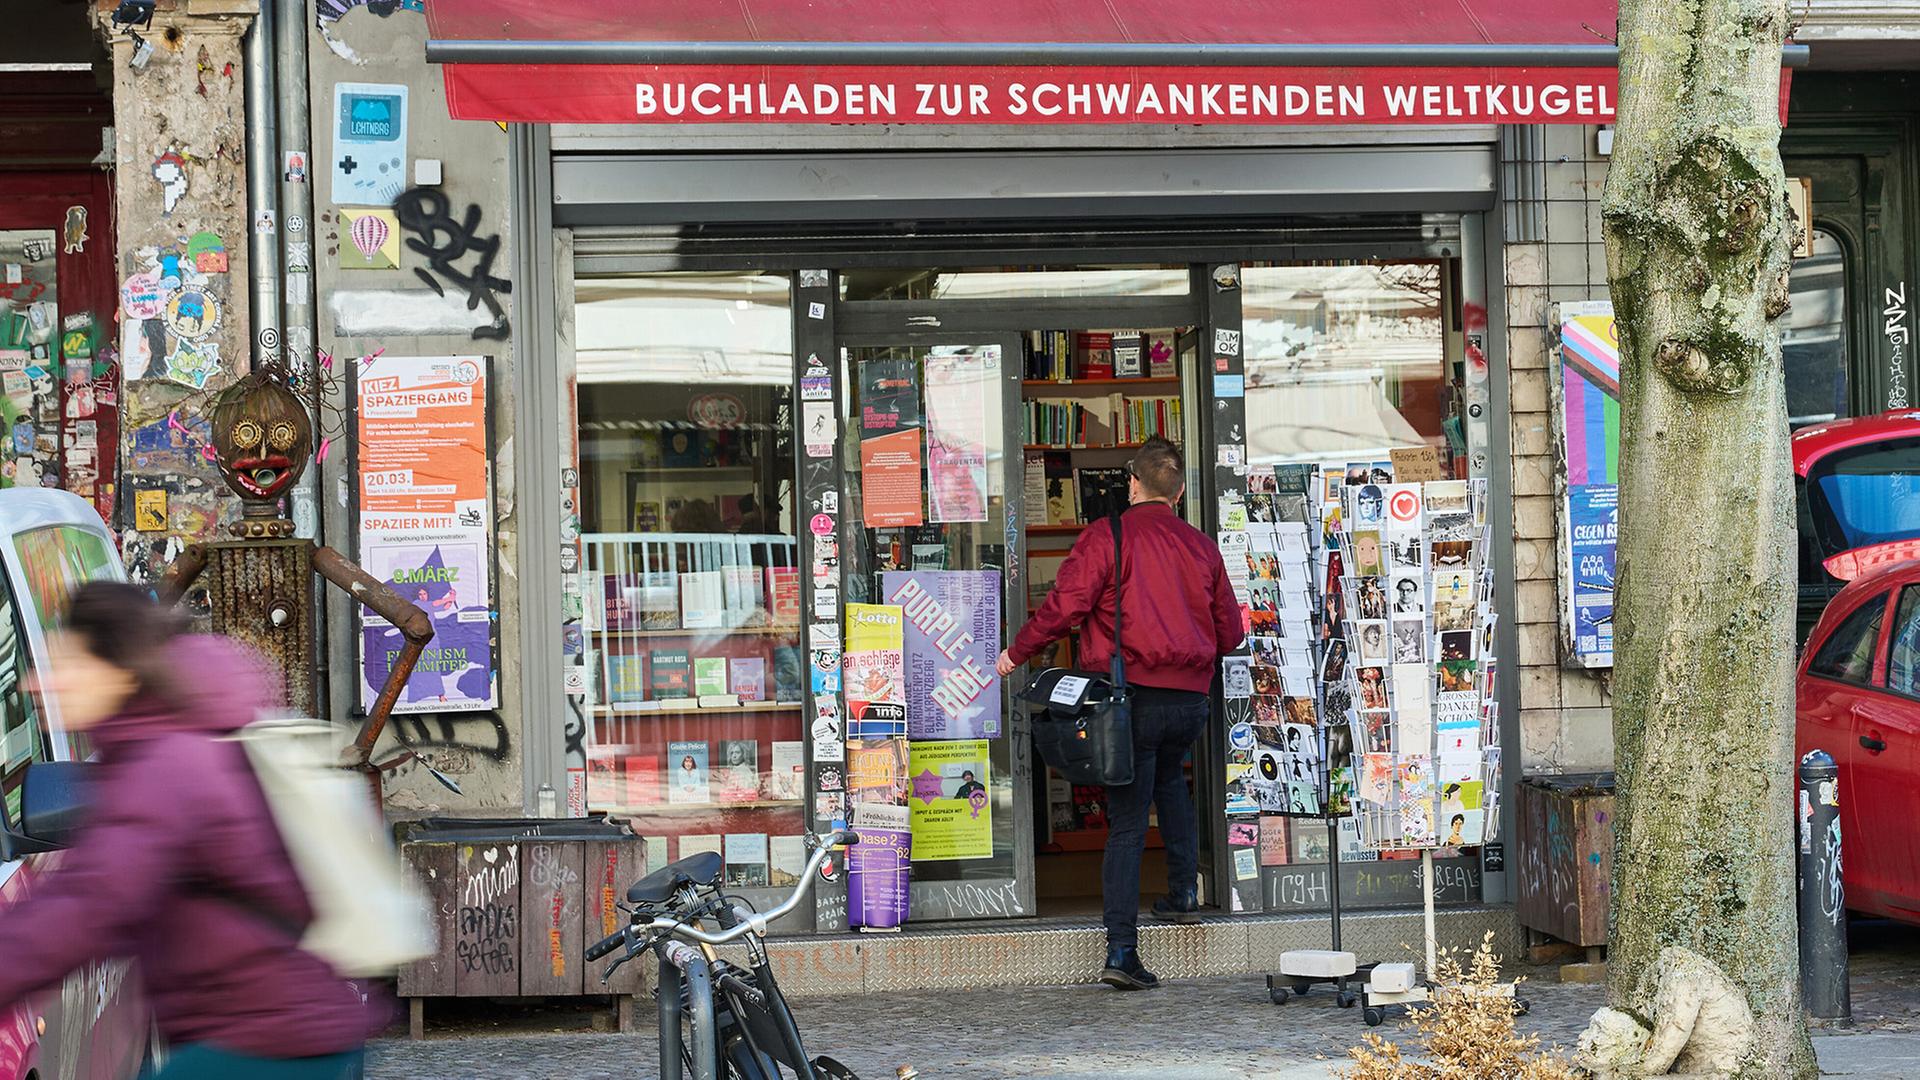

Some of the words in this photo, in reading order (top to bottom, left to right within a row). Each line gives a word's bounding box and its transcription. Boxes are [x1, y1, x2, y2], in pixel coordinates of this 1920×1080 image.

[635, 82, 896, 117] BUCHLADEN
[915, 83, 991, 117] ZUR
[1007, 82, 1366, 118] SCHWANKENDEN
[1382, 83, 1616, 118] WELTKUGEL
[1218, 342, 1237, 354] OK
[363, 379, 397, 395] KIEZ
[366, 391, 468, 408] SPAZIERGANG
[367, 473, 410, 486] 20.03.
[364, 518, 420, 530] SPAZIER
[423, 516, 452, 529] MIT!
[1574, 524, 1606, 541] GEGEN
[984, 595, 996, 608] OF
[890, 576, 976, 662] PURPLE
[984, 608, 996, 635] MARCH
[984, 640, 996, 667] 2026
[912, 651, 923, 735] MARIANNENPLATZ
[930, 653, 994, 720] RIDE
[1438, 691, 1479, 702] GROSSES
[1438, 701, 1478, 712] DANKE
[890, 833, 898, 847] 2
